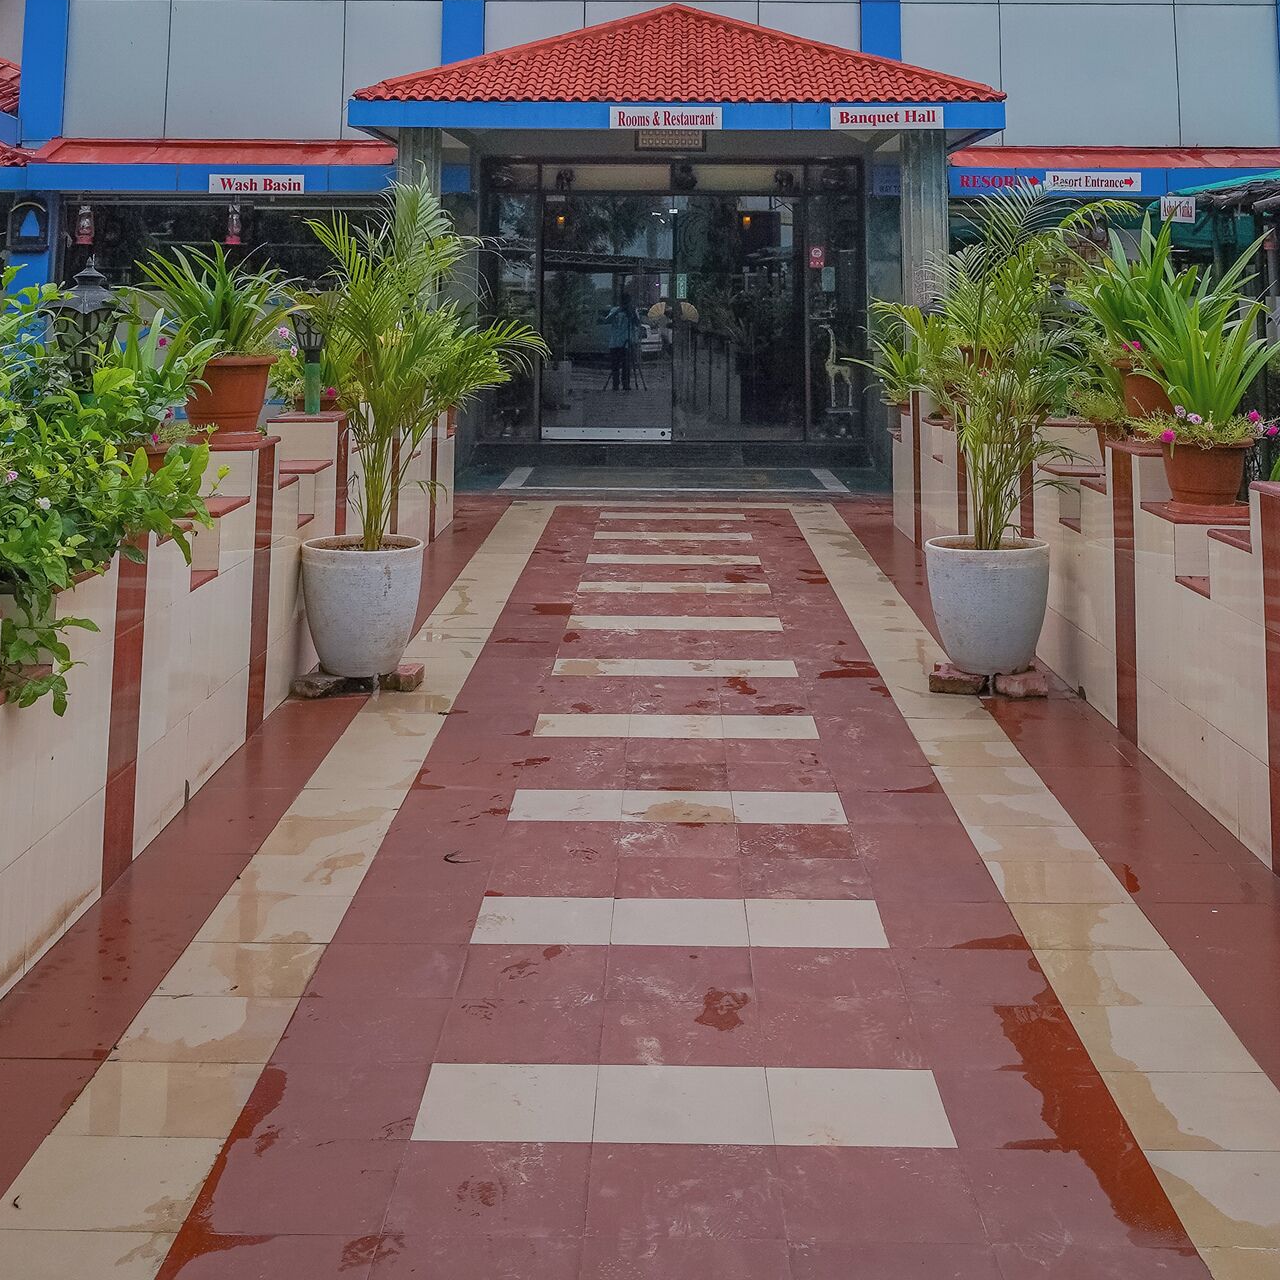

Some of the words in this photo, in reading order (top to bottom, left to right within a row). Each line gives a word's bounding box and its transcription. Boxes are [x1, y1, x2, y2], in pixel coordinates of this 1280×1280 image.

[618, 111, 650, 126] Rooms
[653, 111, 660, 126] &
[663, 111, 714, 126] Restaurant
[839, 111, 899, 126] Banquet
[905, 110, 936, 123] Hall
[220, 178, 257, 191] Wash
[263, 178, 301, 191] Basin
[1085, 175, 1124, 188] Entrance
